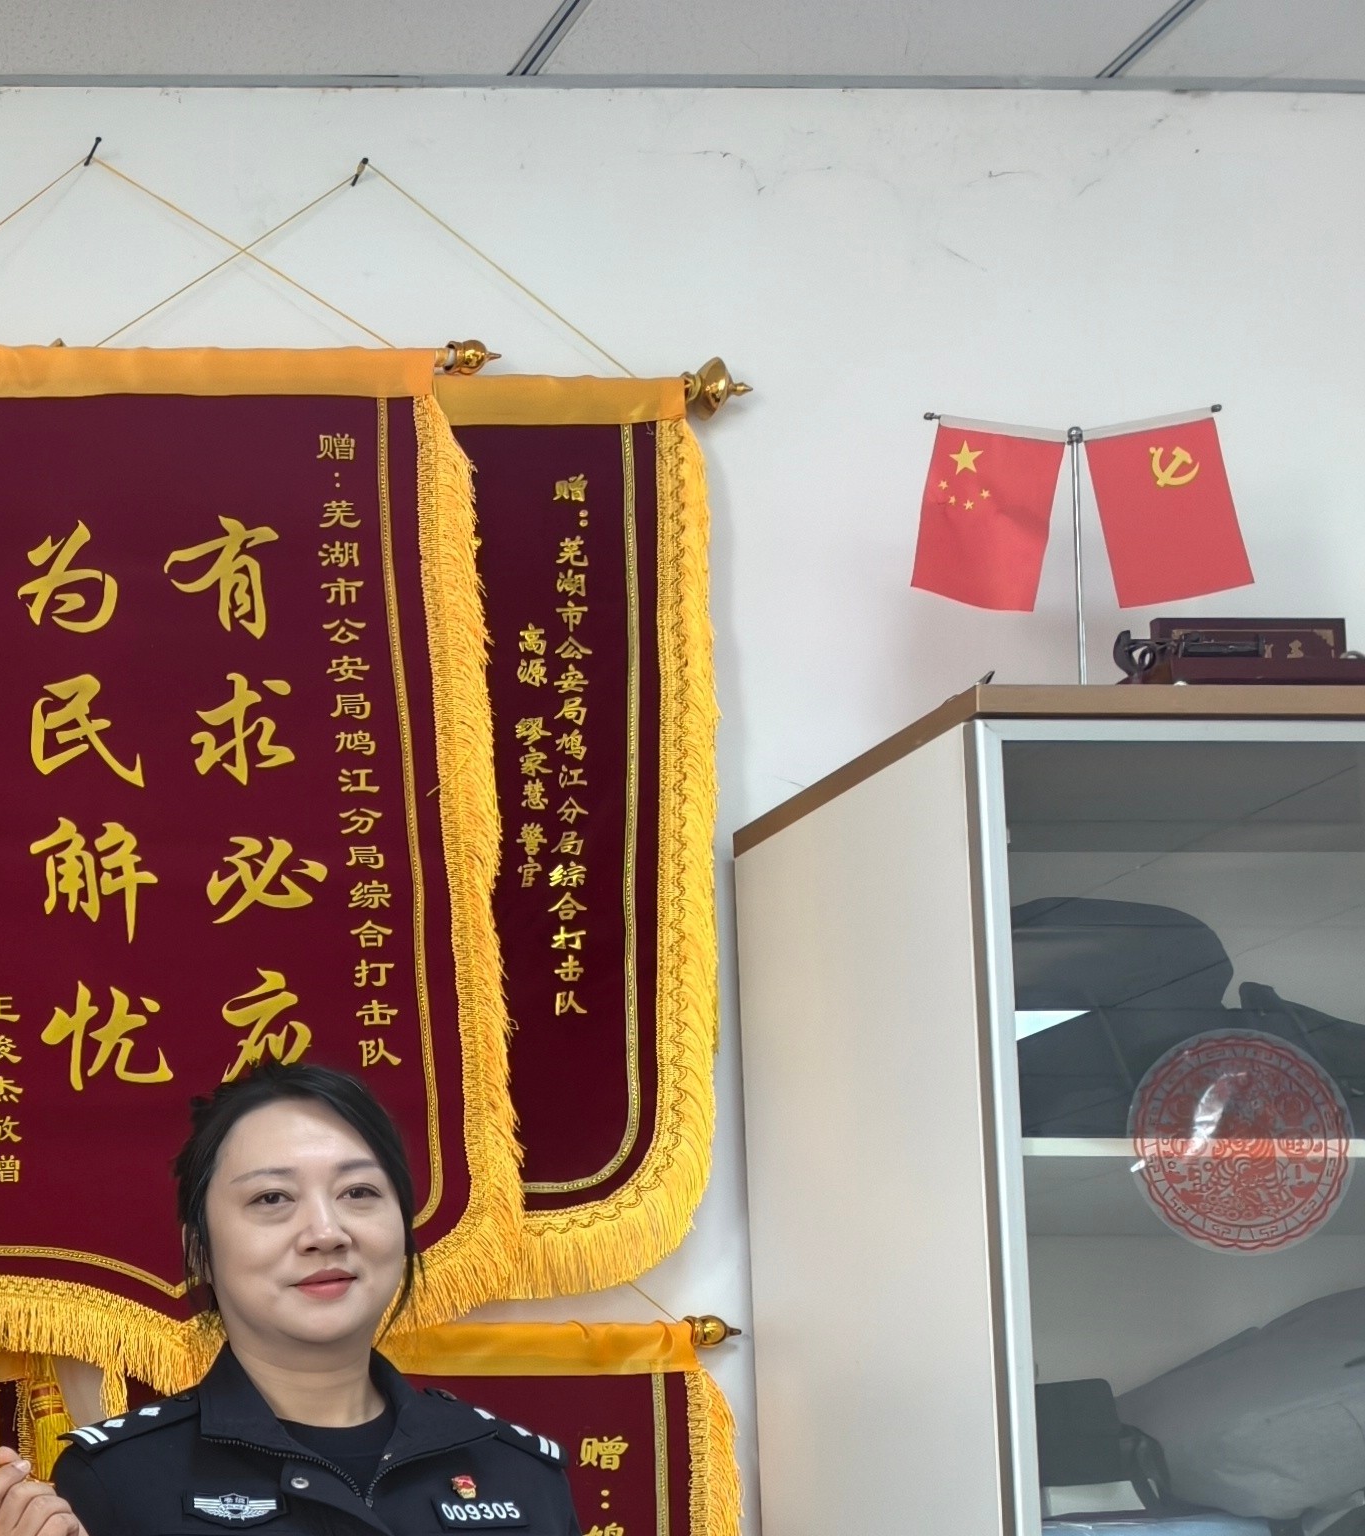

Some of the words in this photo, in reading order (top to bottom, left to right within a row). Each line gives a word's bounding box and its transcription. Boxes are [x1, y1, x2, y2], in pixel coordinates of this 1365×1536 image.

[517, 622, 548, 688] 高源
[17, 519, 173, 1092] 为民解忧
[441, 1501, 521, 1522] 009305
